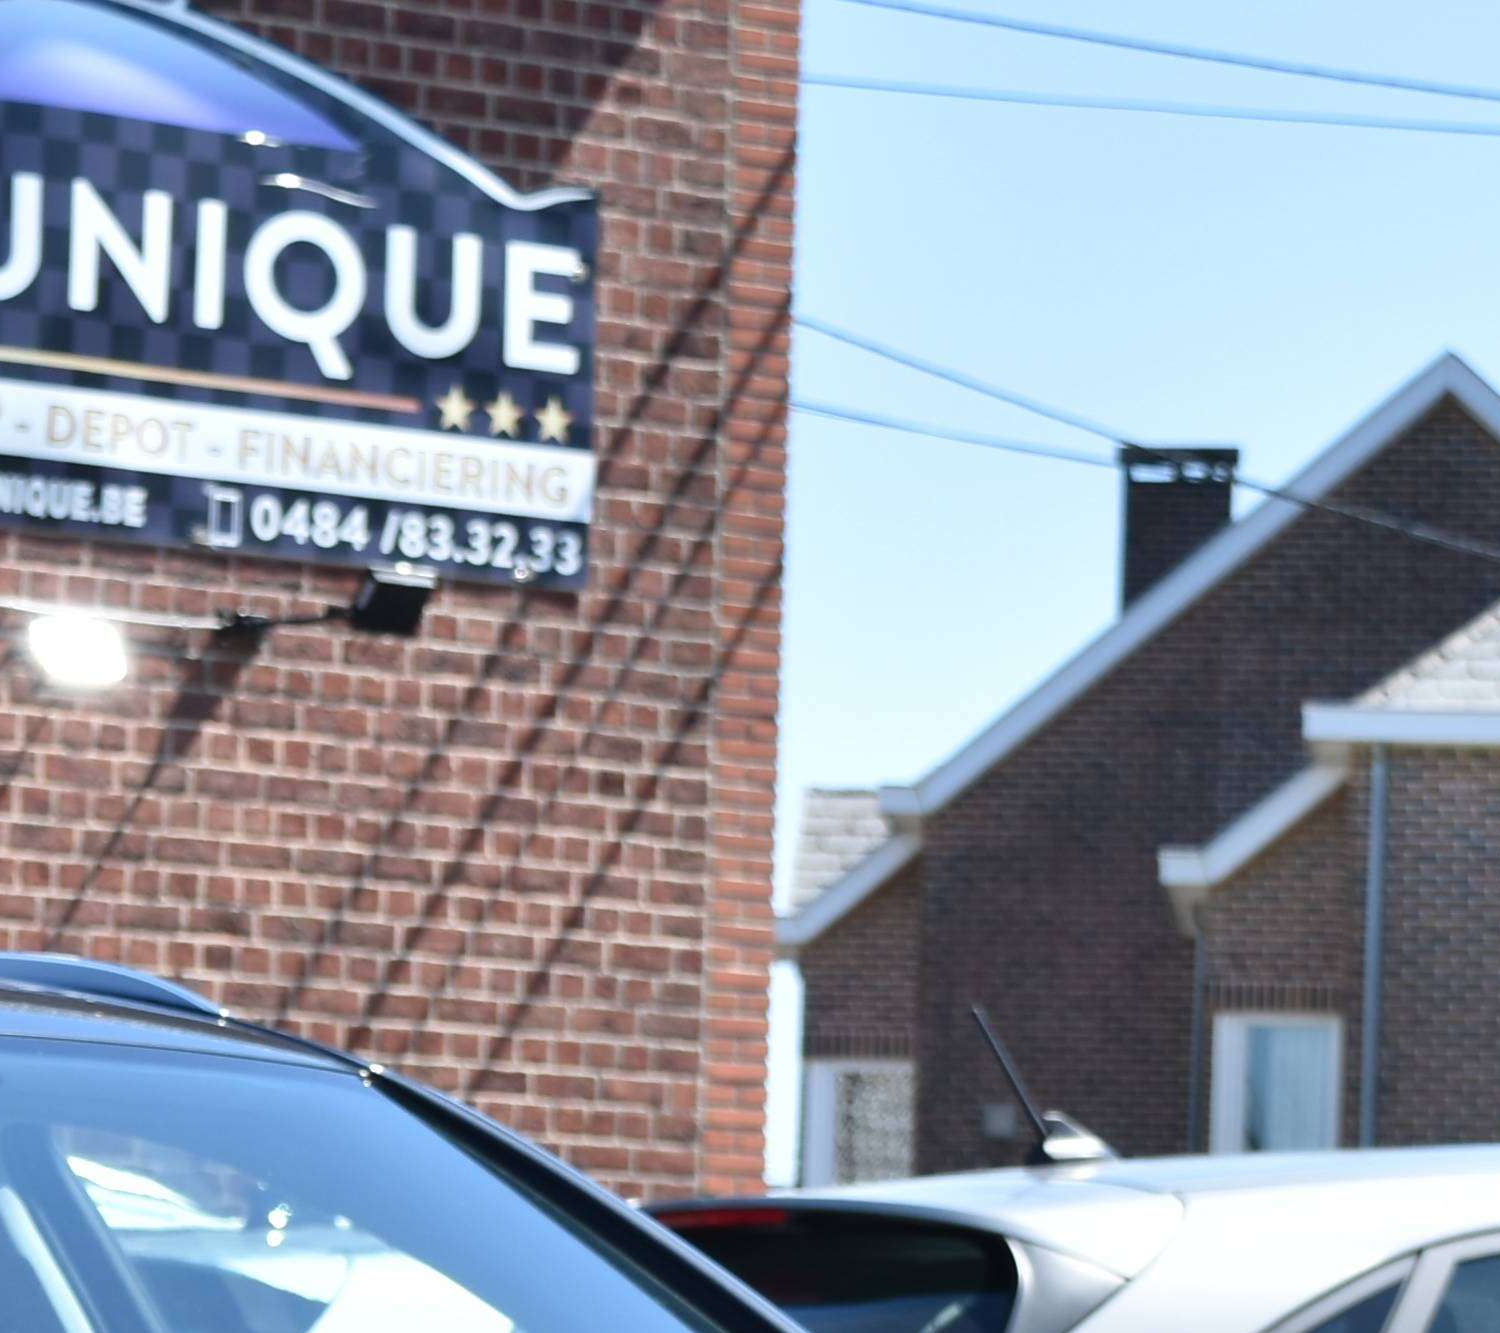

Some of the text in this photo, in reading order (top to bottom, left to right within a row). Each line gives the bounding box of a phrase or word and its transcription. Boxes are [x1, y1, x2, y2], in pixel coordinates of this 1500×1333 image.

[45, 402, 197, 460] DEPOT
[237, 428, 571, 508] FINANCIERING
[249, 493, 370, 552] 0484
